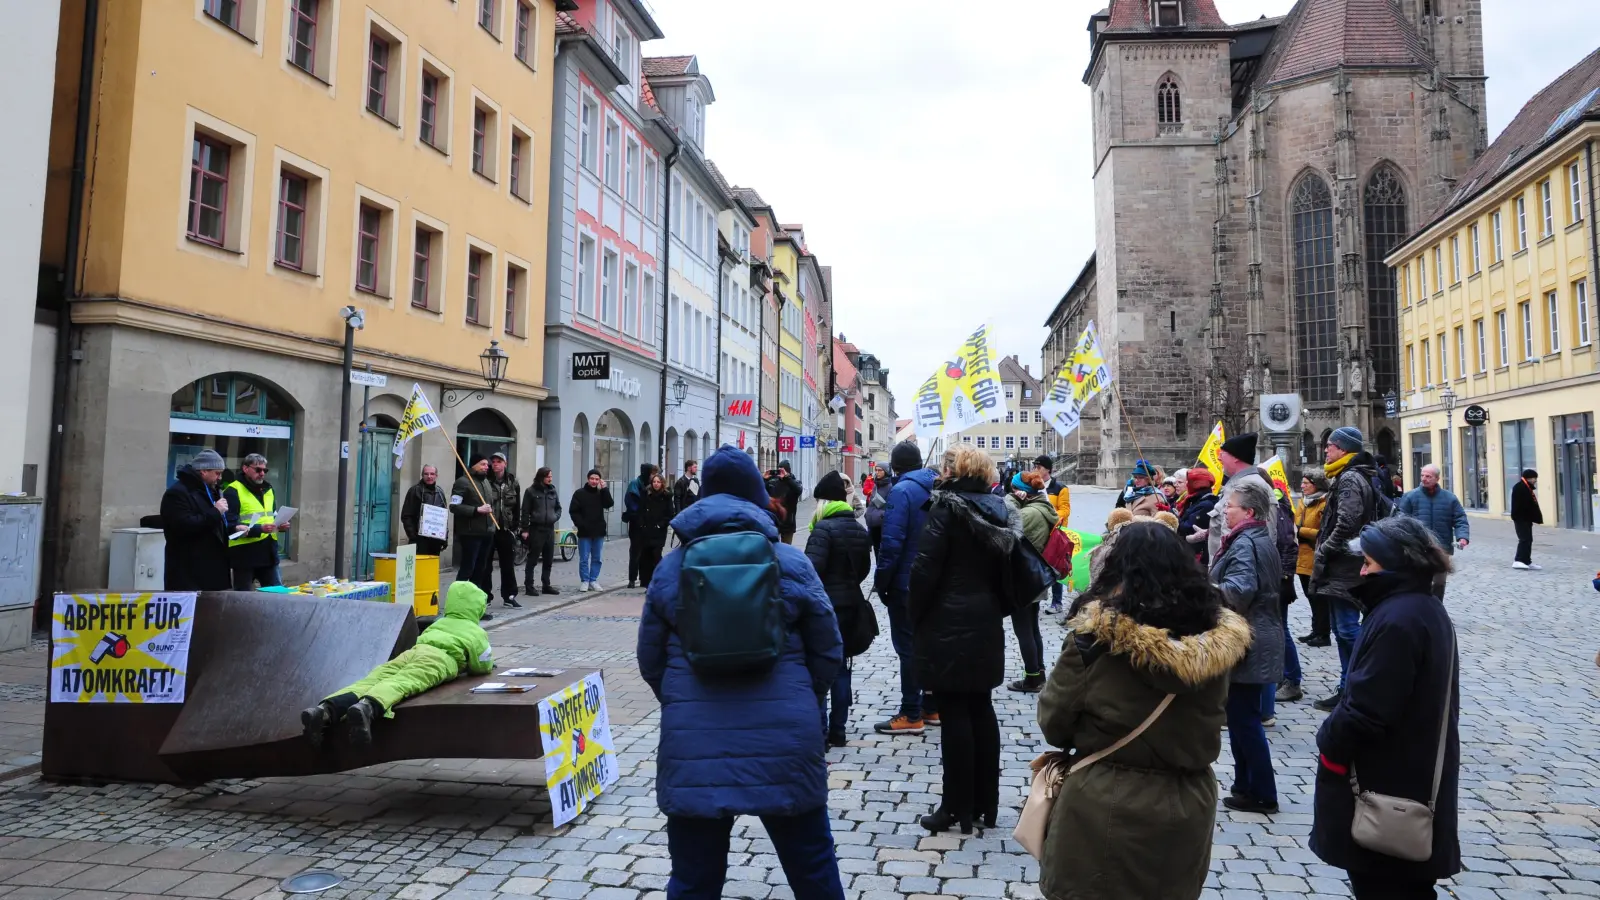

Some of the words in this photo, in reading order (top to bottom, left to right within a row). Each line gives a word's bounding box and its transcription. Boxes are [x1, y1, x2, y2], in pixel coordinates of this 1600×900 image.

[574, 355, 606, 367] MATT
[577, 368, 601, 377] optik
[971, 378, 999, 414] FÜR
[727, 399, 753, 417] H&M
[246, 426, 256, 435] vhs
[64, 603, 138, 631] ABPFIFF
[144, 597, 183, 630] FÜR
[155, 644, 175, 653] BUND
[61, 668, 176, 693] ATOMKRAFT!
[547, 692, 583, 742] ABPFIFF
[583, 681, 601, 717] FÜR
